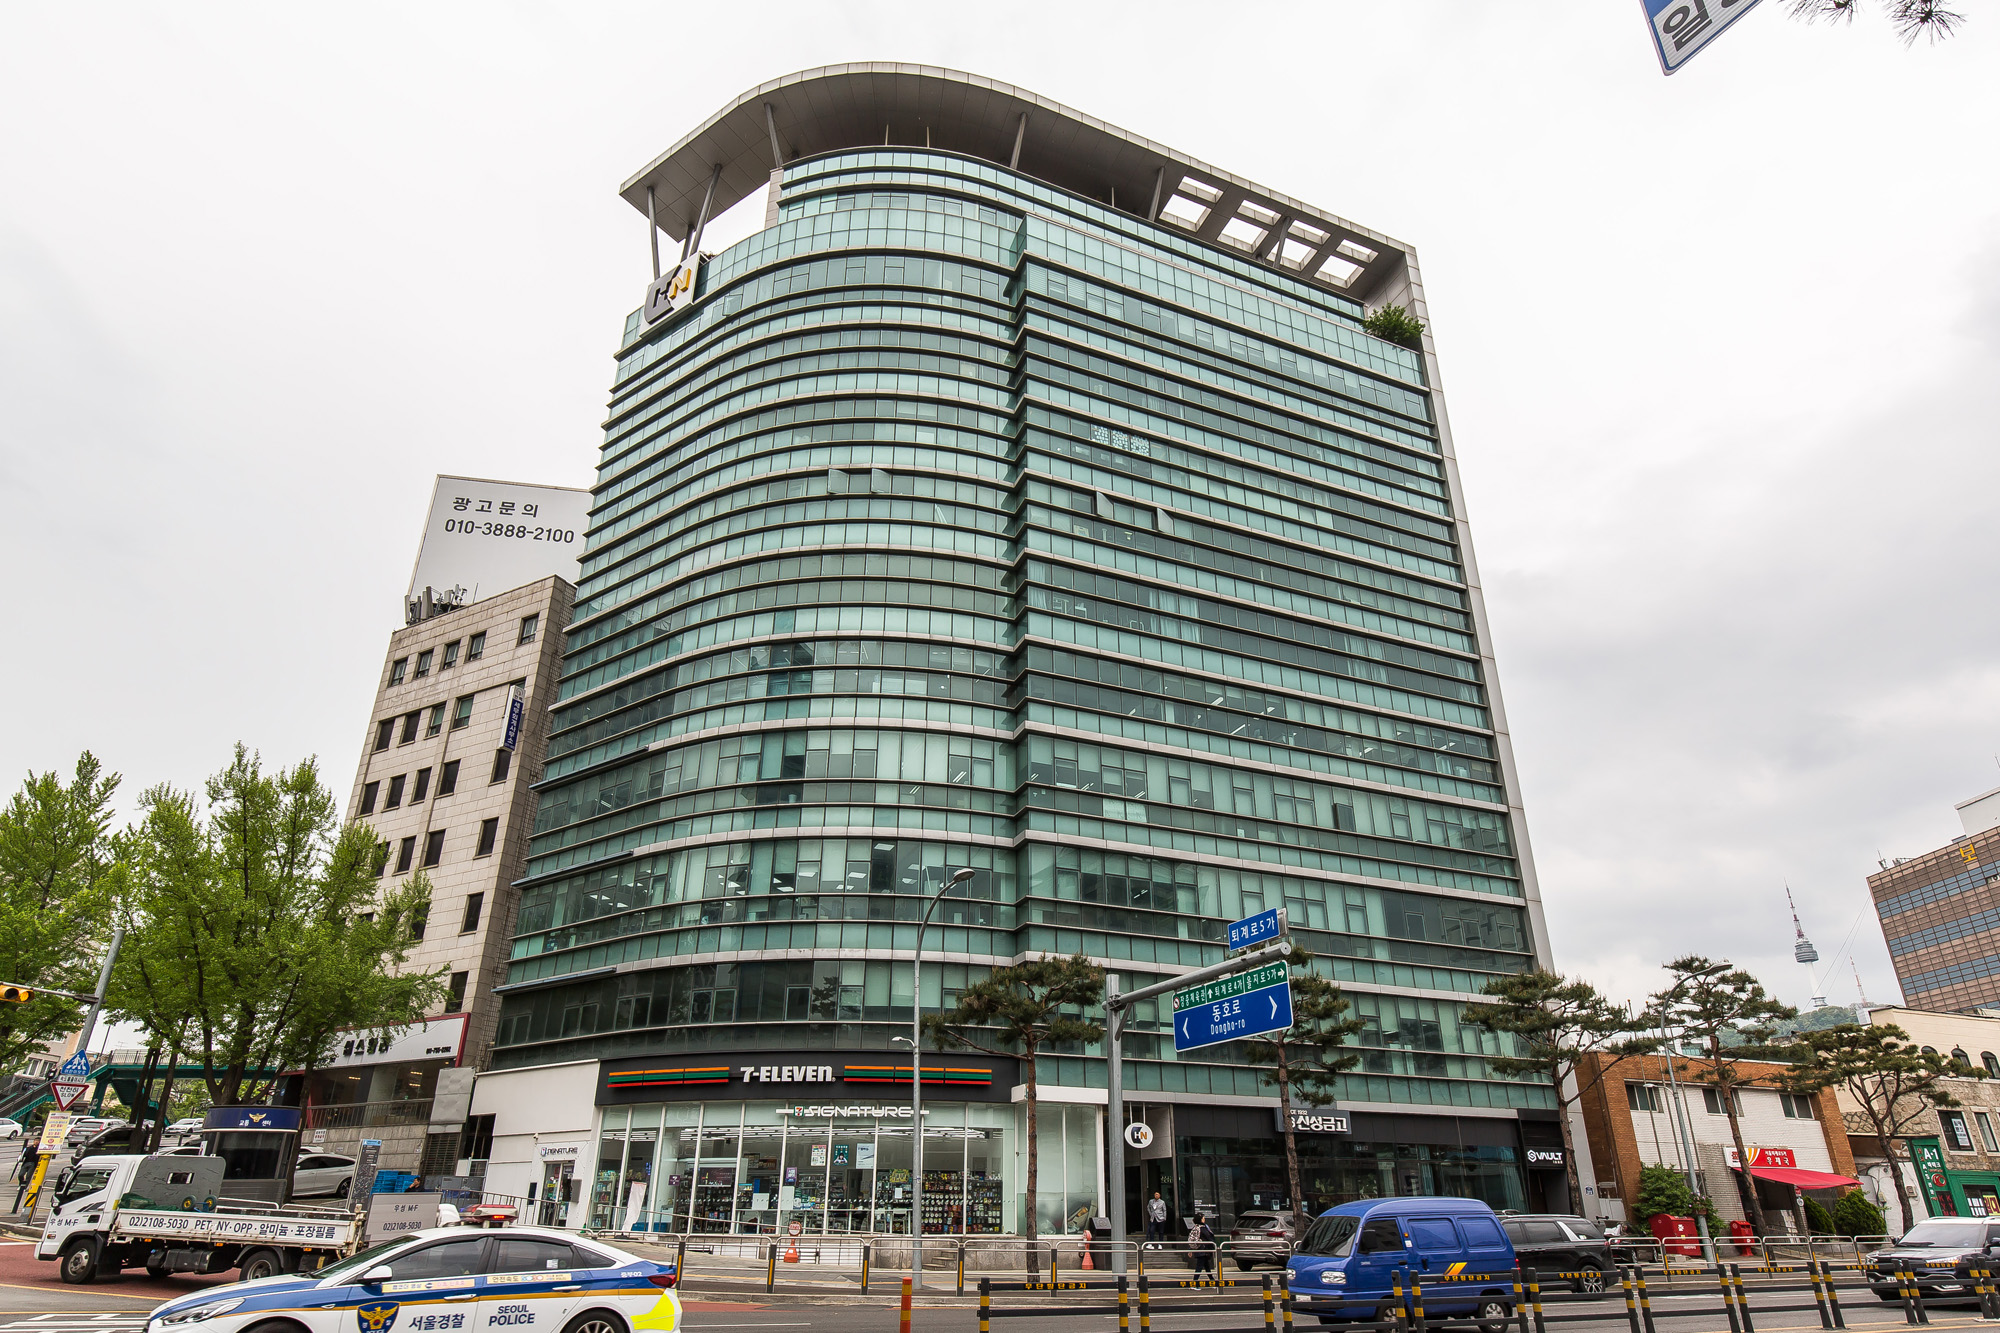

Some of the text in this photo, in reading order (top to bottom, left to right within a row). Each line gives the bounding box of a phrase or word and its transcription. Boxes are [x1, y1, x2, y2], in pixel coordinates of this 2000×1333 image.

[444, 518, 575, 544] 010-3888-2100
[1231, 916, 1276, 942] 퇴계로5가
[1246, 968, 1277, 989] 을지로5가
[1214, 979, 1243, 997] 퇴계로4가
[1212, 1000, 1242, 1022] 동호로
[1210, 1018, 1246, 1035] Dongho-ro
[805, 1106, 912, 1117] SIGNATURE
[238, 1119, 272, 1127] 교통 센터
[1296, 1115, 1348, 1132] 신성금고
[1536, 1152, 1562, 1160] VAULT
[1766, 1157, 1790, 1166] 우체국
[393, 1204, 406, 1212] 우성
[50, 1218, 63, 1226] 우성
[129, 1216, 189, 1230] 02)2108-5030
[295, 1225, 336, 1239] 포장필름
[383, 1221, 422, 1231] 02)2108-5030
[497, 1304, 529, 1314] SEOUL
[408, 1313, 465, 1331] 서울경찰
[488, 1313, 536, 1326] POLICE
